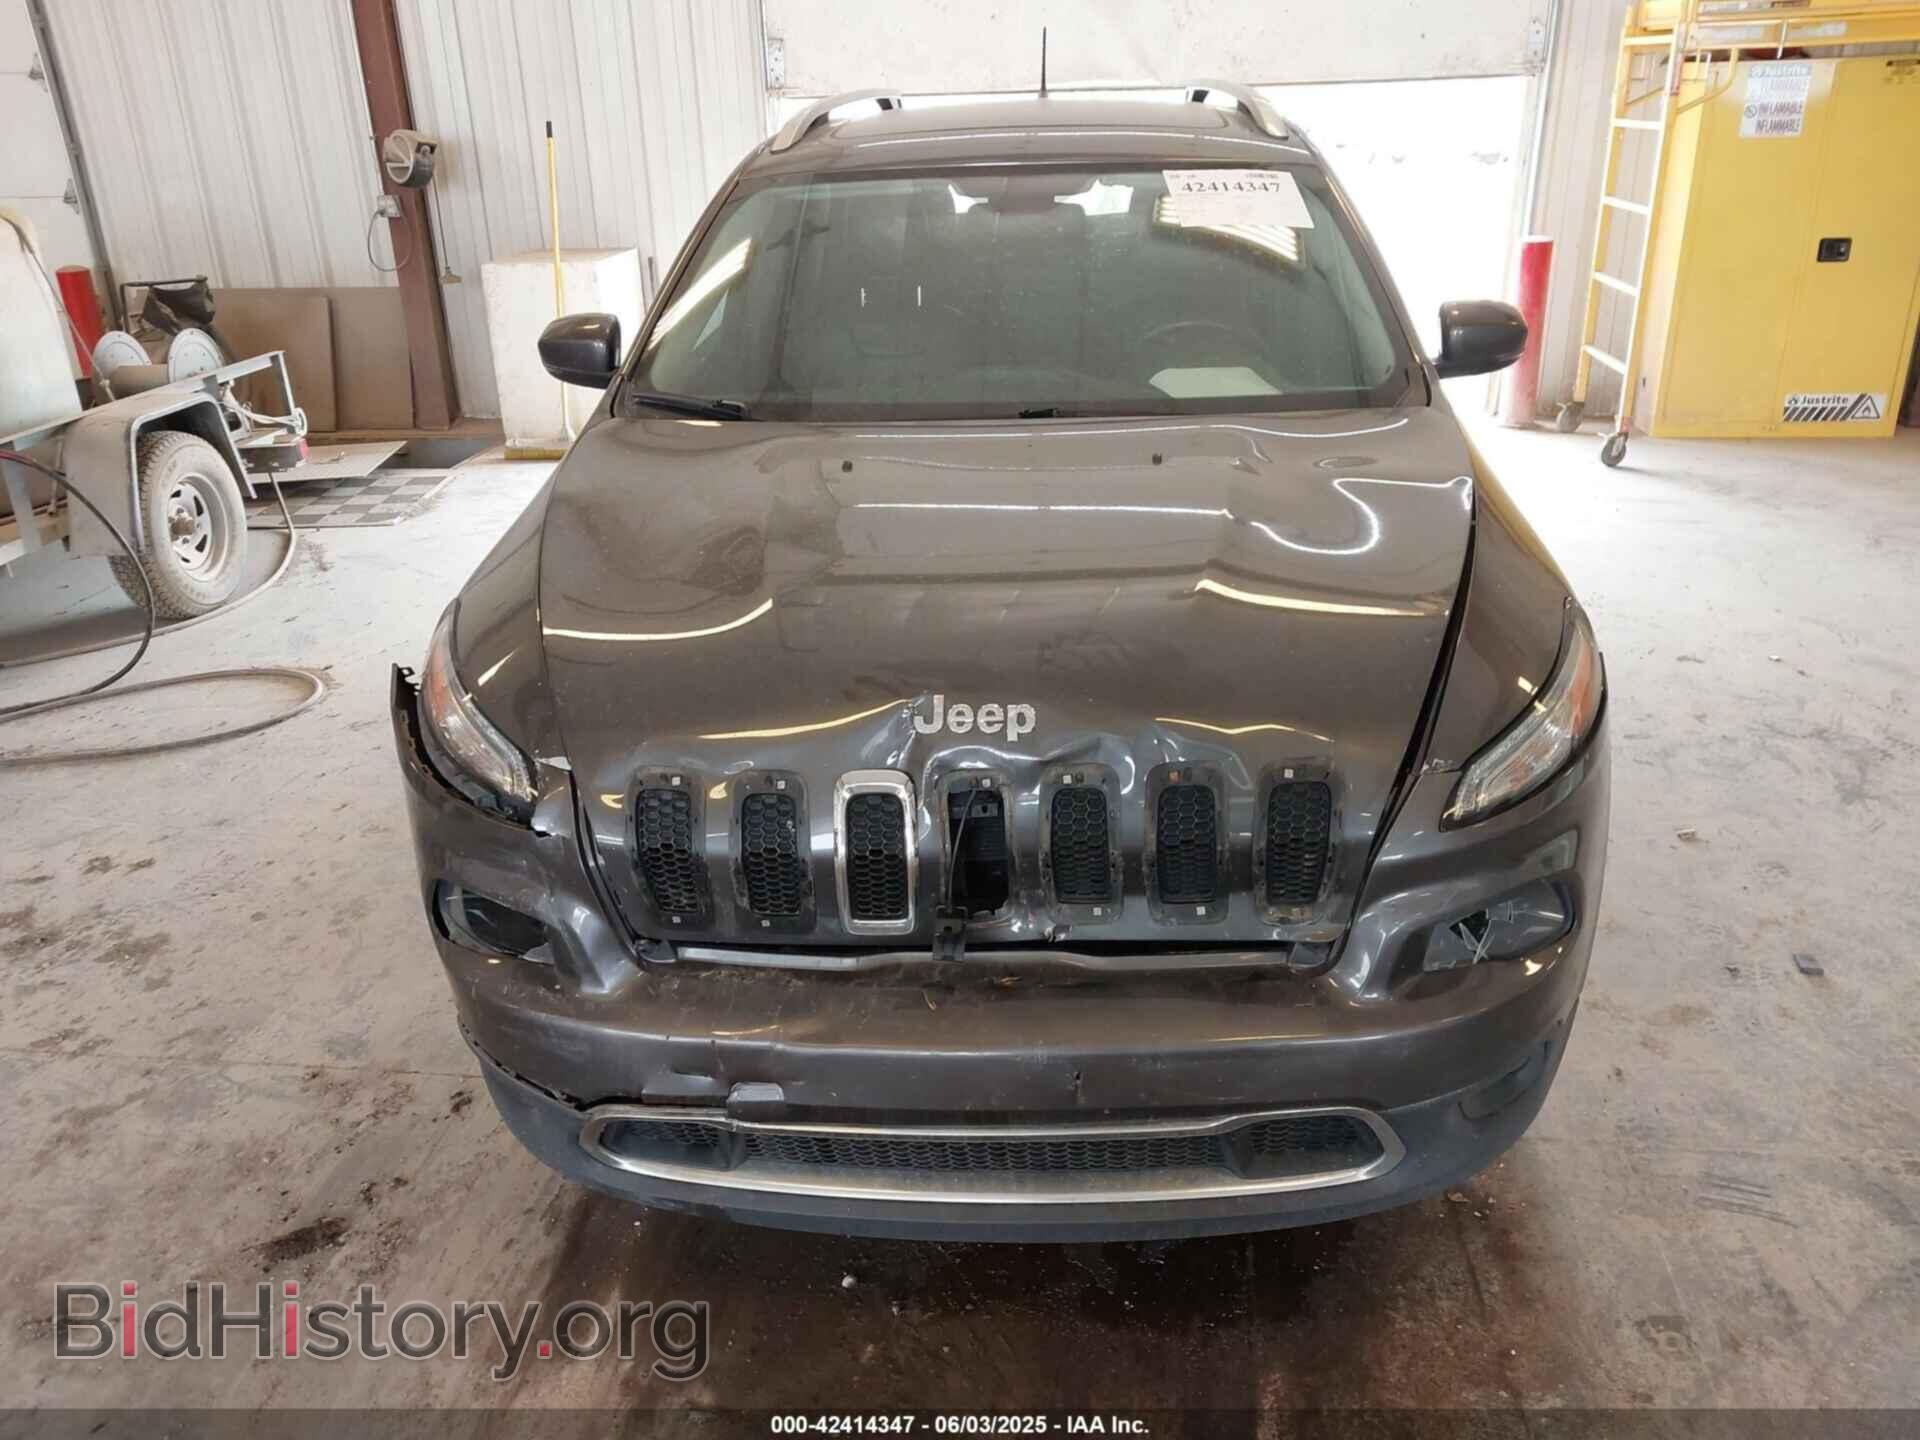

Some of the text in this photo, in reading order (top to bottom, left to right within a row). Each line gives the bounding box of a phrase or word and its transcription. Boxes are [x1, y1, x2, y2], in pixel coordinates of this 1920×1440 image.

[1181, 181, 1281, 193] 42414347
[1801, 395, 1849, 405] Justrite
[913, 694, 1036, 742] Jeep
